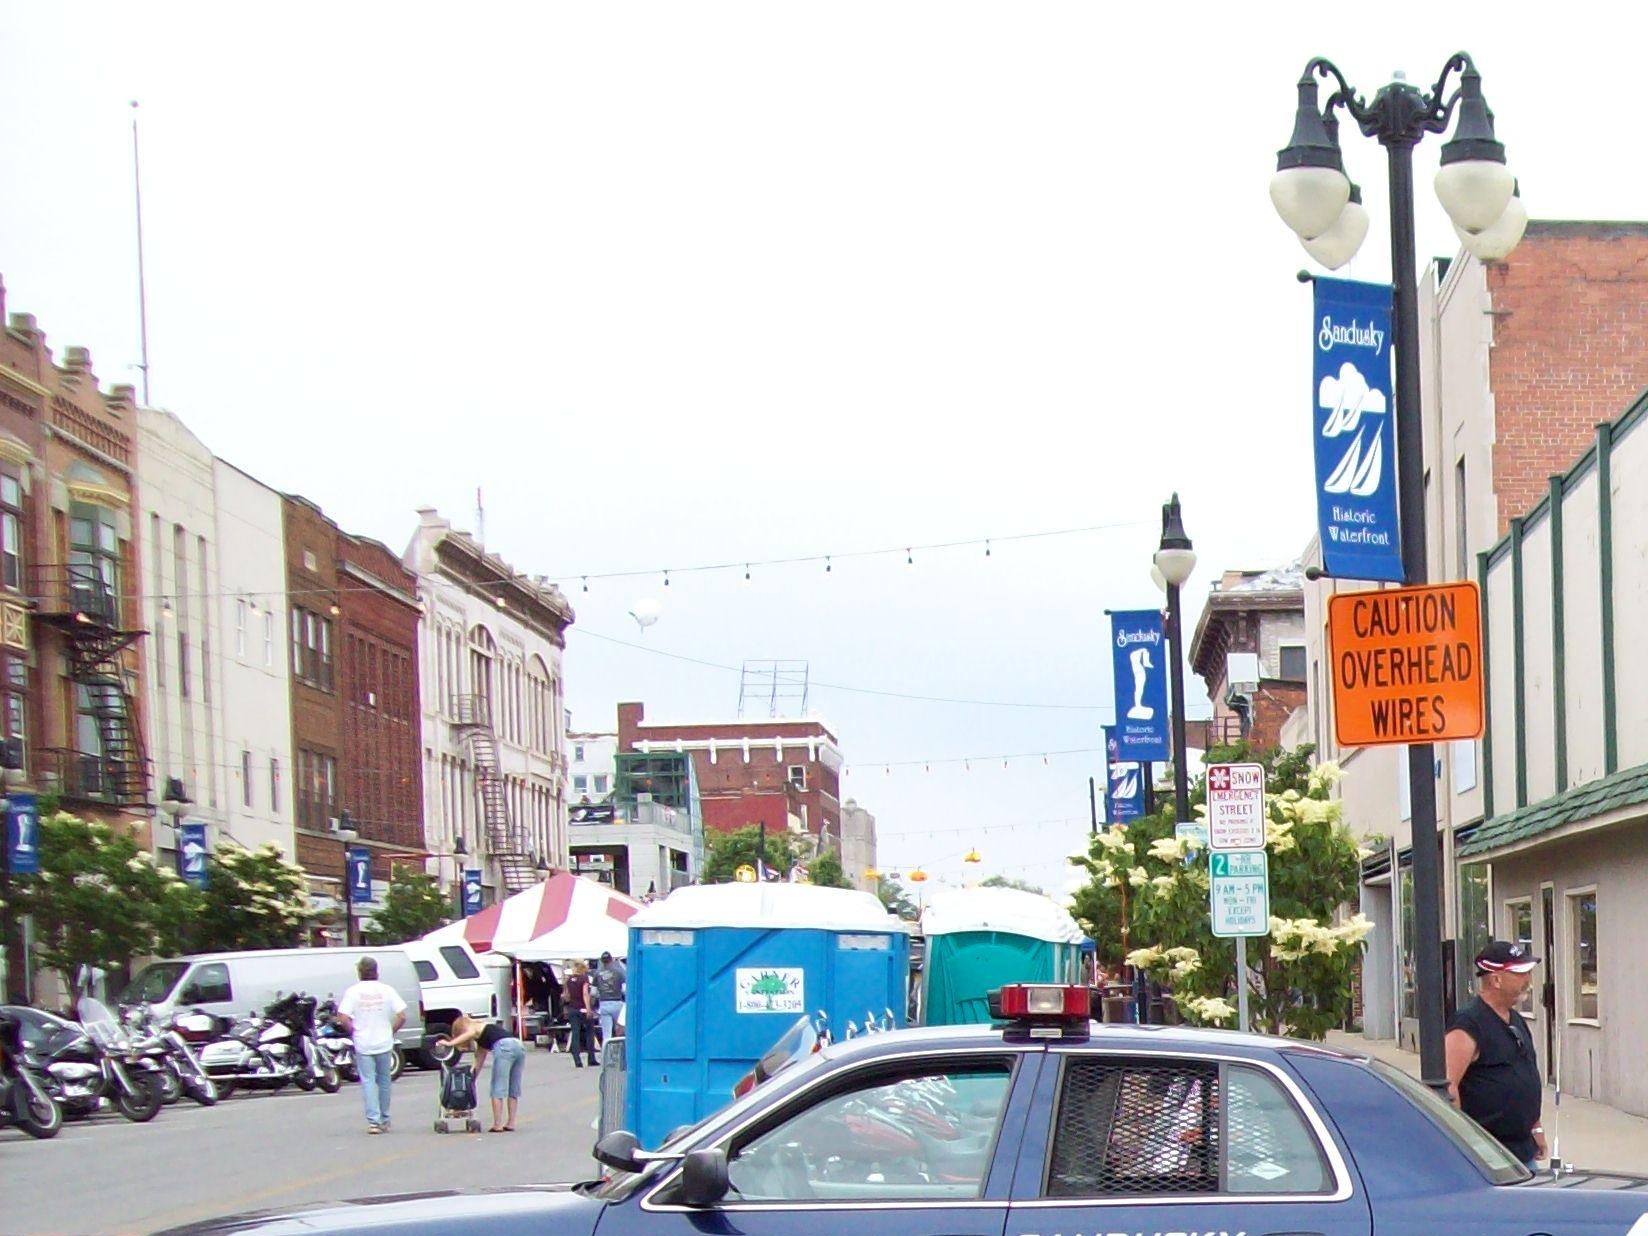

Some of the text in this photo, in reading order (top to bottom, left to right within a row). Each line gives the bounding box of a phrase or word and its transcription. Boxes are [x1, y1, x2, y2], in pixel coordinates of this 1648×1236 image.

[1318, 315, 1385, 356] Sandusky
[1332, 505, 1376, 524] Historic
[1328, 526, 1390, 545] Waterfront
[1353, 592, 1457, 639] CAUTION
[1341, 642, 1473, 690] OVERHEAD
[1370, 694, 1447, 738] WIRES
[1231, 771, 1260, 785] SNOW
[1212, 790, 1259, 801] EMERGENCY
[1219, 804, 1254, 816] STREET
[1215, 854, 1226, 876] 2
[1229, 864, 1263, 874] PARKING
[1215, 884, 1221, 895] 9
[1223, 884, 1235, 895] AM
[1244, 884, 1250, 894] 5
[1252, 883, 1264, 894] PM
